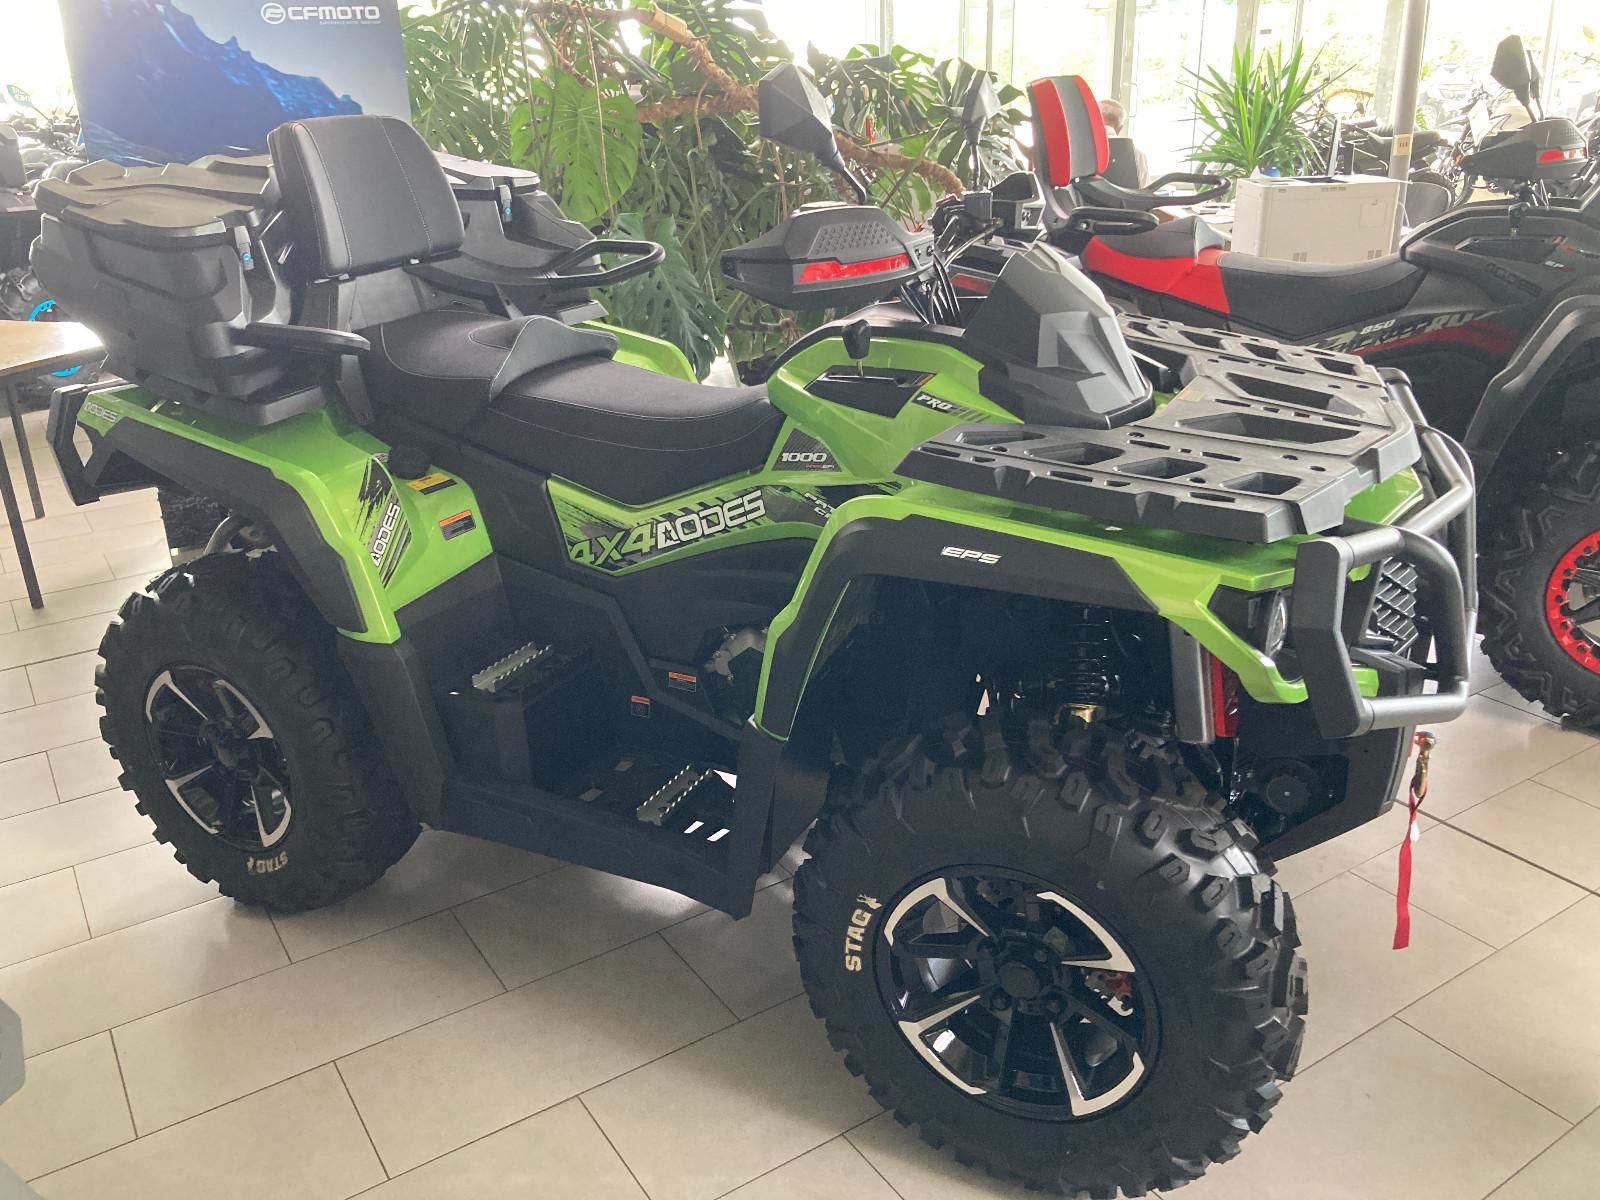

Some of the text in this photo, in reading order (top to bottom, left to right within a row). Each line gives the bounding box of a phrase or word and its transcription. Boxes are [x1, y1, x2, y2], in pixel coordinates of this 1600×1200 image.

[287, 5, 381, 20] CFMOTO
[1360, 318, 1397, 335] 850
[916, 393, 953, 411] PRO
[781, 452, 827, 462] 1000
[656, 489, 766, 550] AODES
[370, 502, 401, 568] AODES
[941, 546, 1003, 564] EPS
[845, 908, 873, 972] STAG
